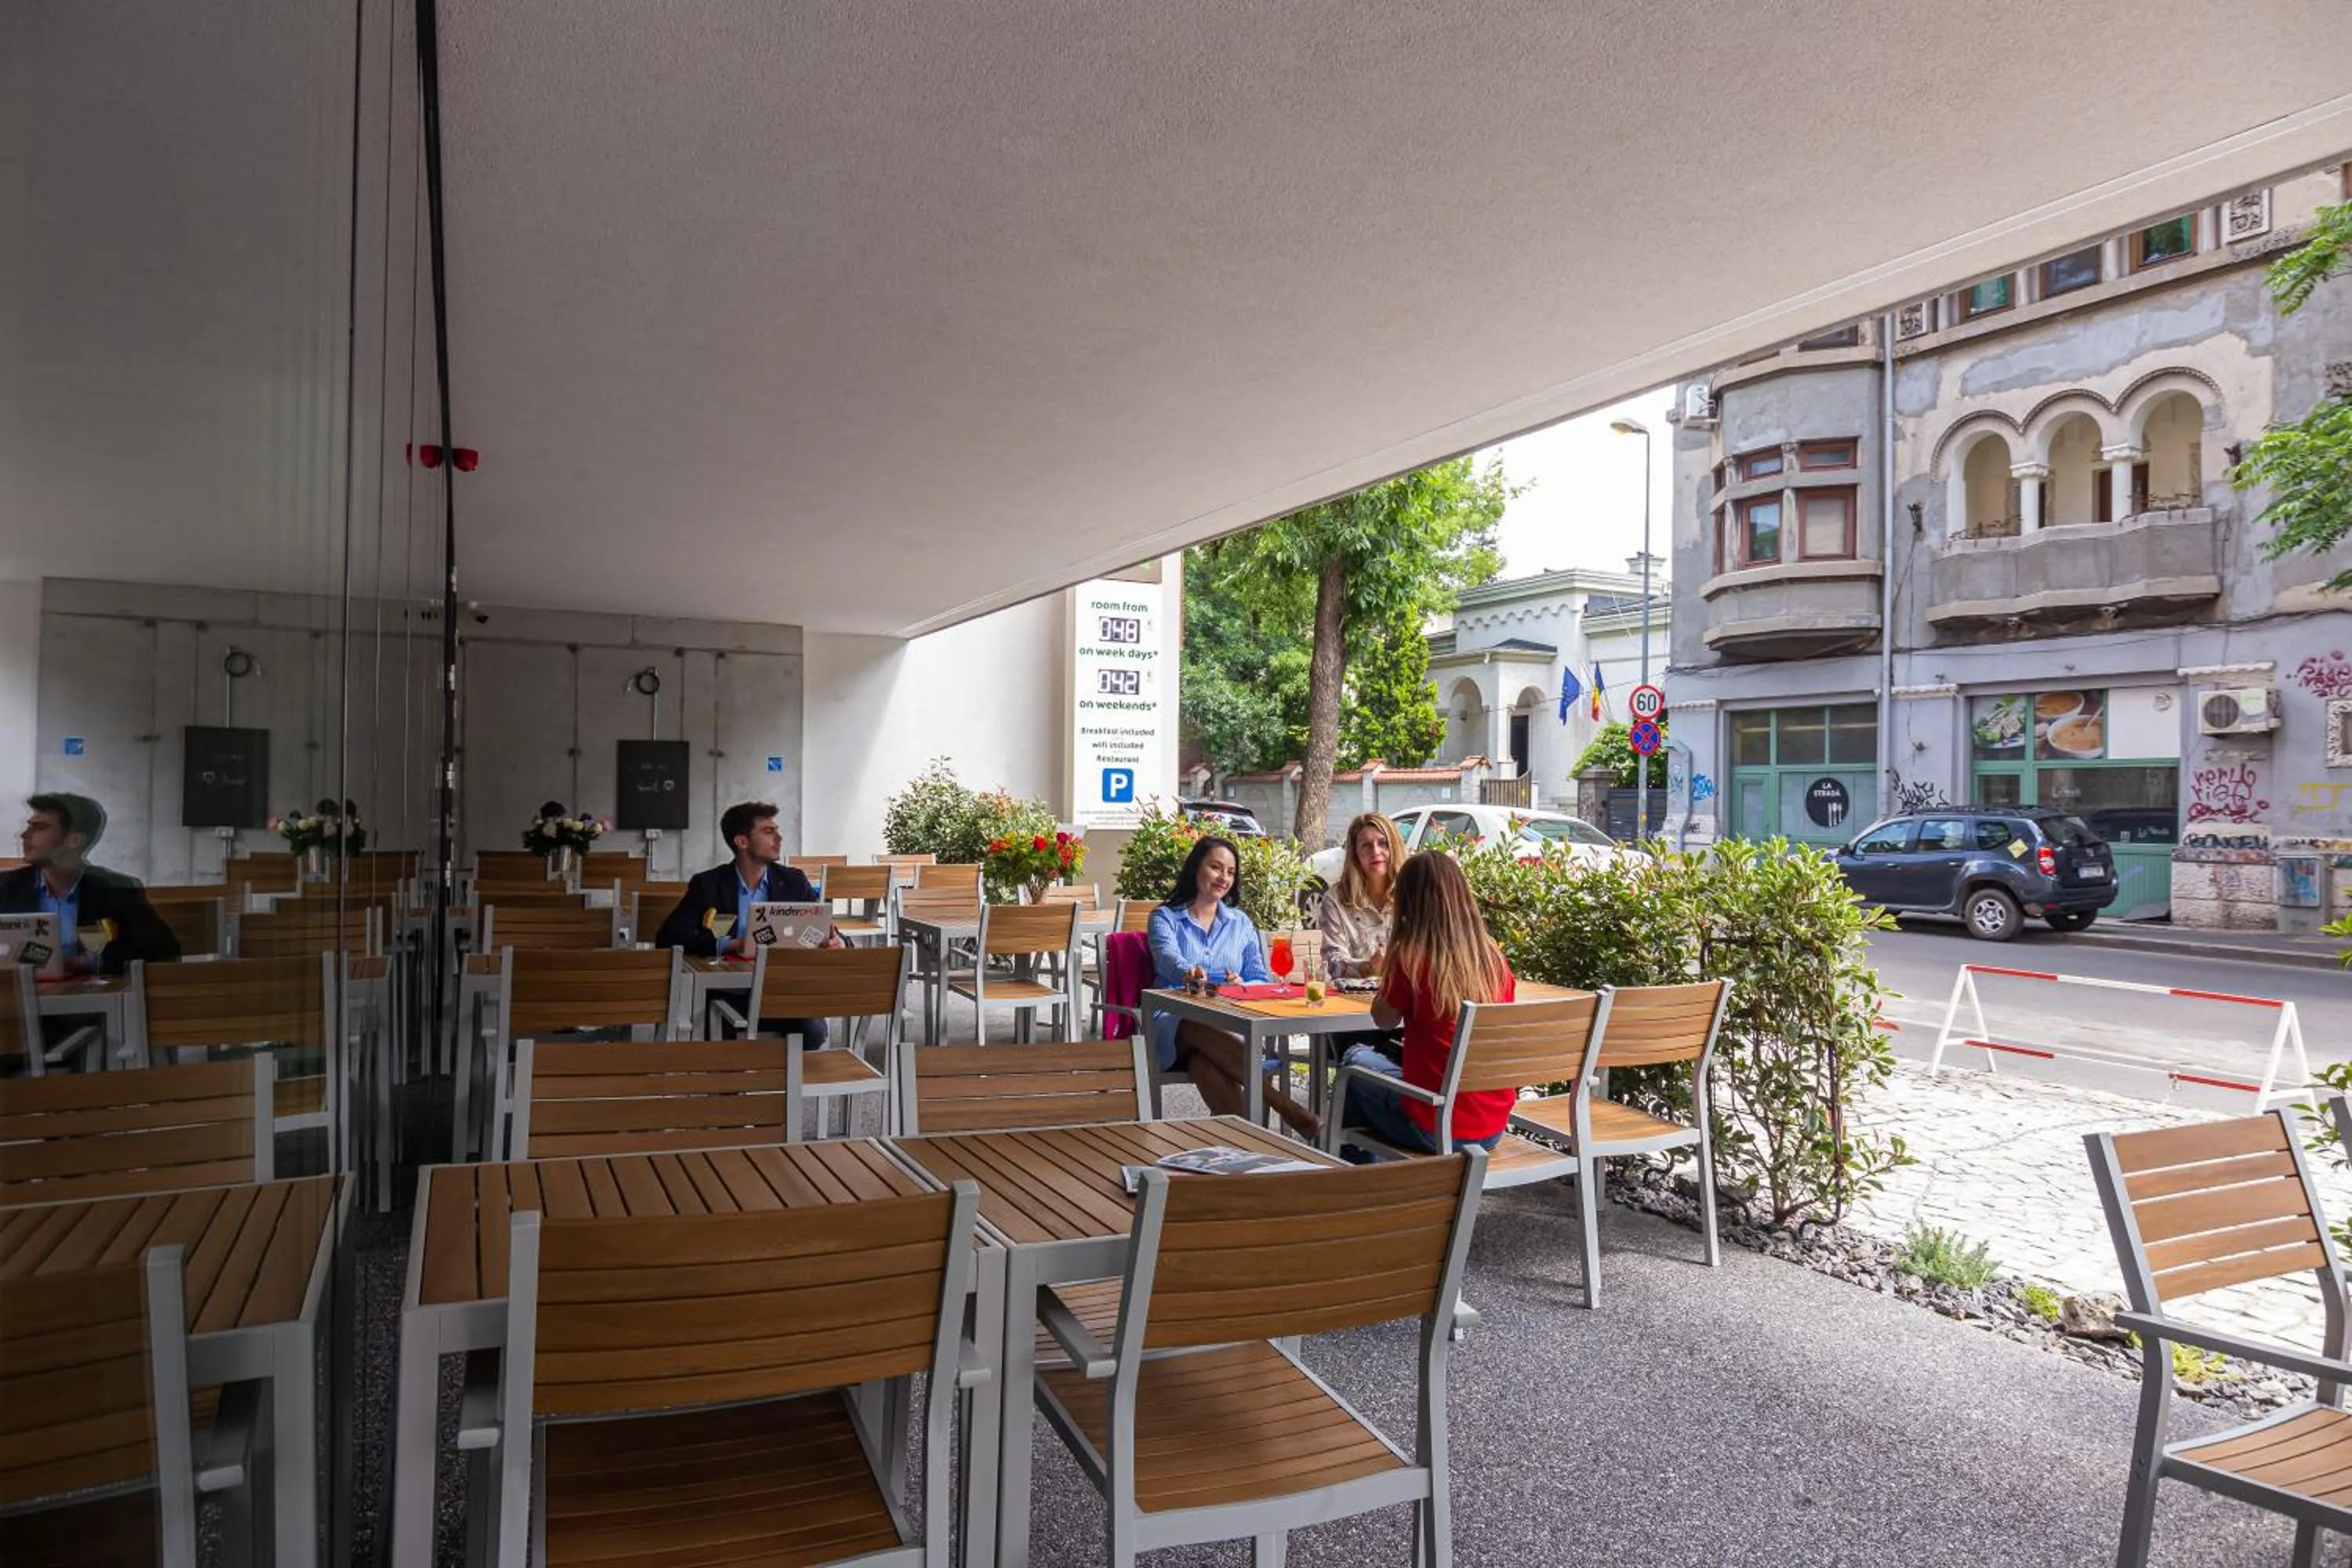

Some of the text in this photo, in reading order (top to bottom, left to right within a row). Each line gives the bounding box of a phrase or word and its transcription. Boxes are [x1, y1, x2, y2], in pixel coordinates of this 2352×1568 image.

[1091, 601, 1148, 612] room from
[1100, 618, 1138, 642] 048
[1095, 648, 1125, 658] week
[1098, 670, 1137, 694] 042
[1079, 700, 1094, 709] on
[1636, 693, 1657, 712] 60
[1109, 742, 1144, 750] included
[1096, 754, 1139, 764] Restaurant
[1109, 773, 1128, 798] P
